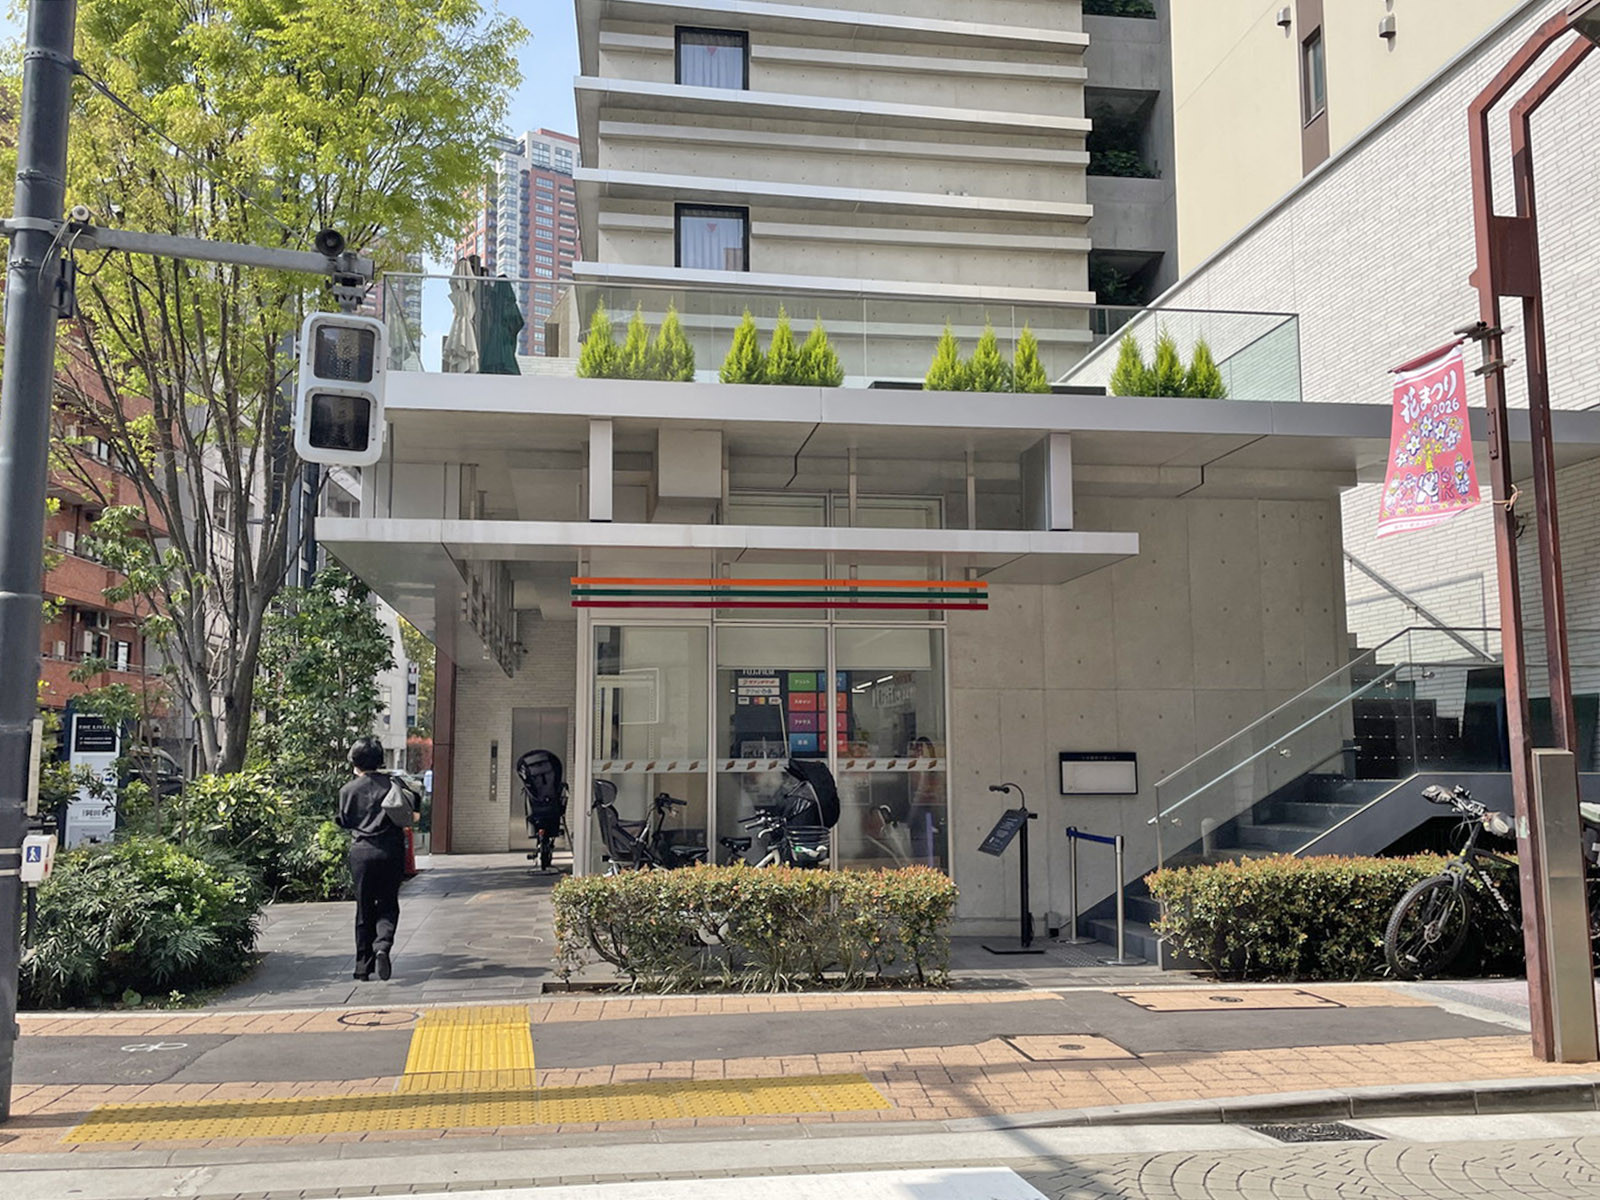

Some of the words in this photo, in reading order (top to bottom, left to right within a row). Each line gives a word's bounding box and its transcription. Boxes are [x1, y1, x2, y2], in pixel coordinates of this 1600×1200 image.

[1400, 369, 1457, 423] 花まつり
[1432, 397, 1460, 418] 2026
